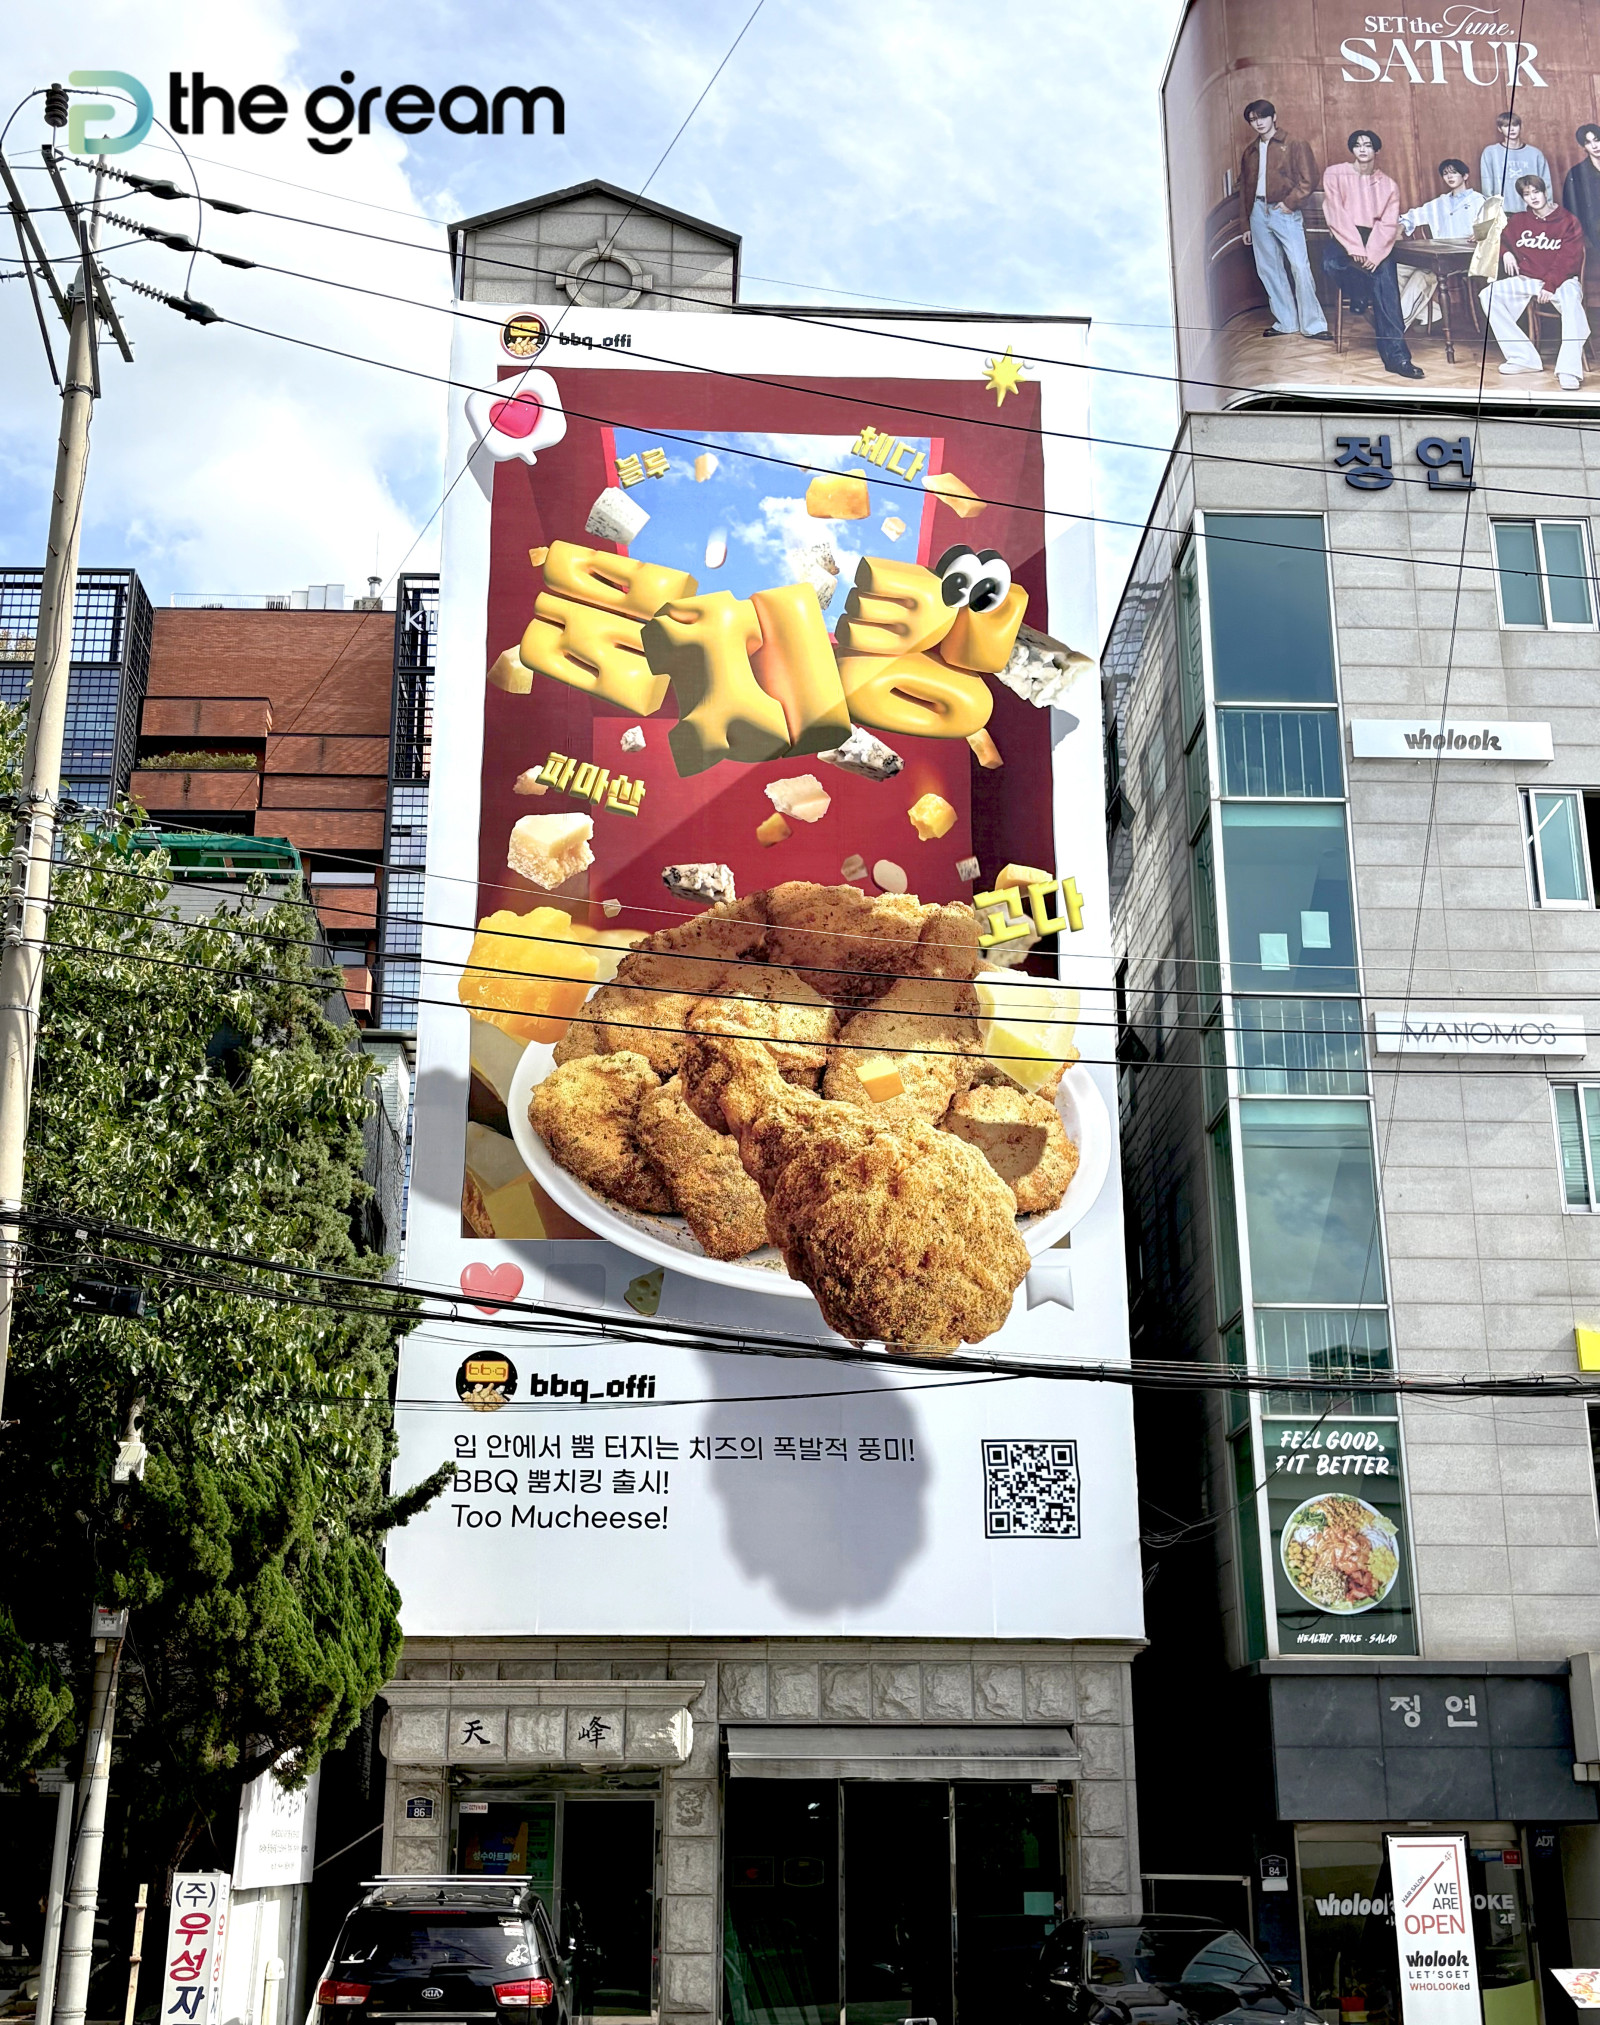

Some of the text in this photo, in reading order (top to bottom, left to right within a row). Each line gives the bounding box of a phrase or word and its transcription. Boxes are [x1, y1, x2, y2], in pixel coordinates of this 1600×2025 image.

[1364, 15, 1408, 33] SET
[1410, 17, 1444, 34] the
[1340, 37, 1549, 87] SATUR
[851, 425, 926, 482] 체다
[1403, 728, 1502, 750] wholook
[535, 751, 646, 817] 파마산
[973, 876, 1084, 948] 고다
[1404, 1022, 1557, 1045] MANOMOS
[530, 1373, 656, 1404] bbq_offi
[454, 1434, 915, 1462] 입 안에서 뿜 터지는 치즈의 폭발적 풍미!
[1281, 1430, 1385, 1452] FEEL GOOD,
[1275, 1454, 1390, 1476] FIT BETTER
[453, 1469, 669, 1496] BBQ 뿜치킹 출시!
[451, 1504, 668, 1530] Too Mucheese!
[1296, 1633, 1398, 1644] HEALTHY POKE SALAD
[413, 1807, 426, 1817] 86
[1535, 1835, 1555, 1847] ADT
[1268, 1866, 1280, 1876] 84
[1410, 1875, 1426, 1893] SALON
[1433, 1882, 1458, 1895] WE
[1432, 1897, 1459, 1910] ARE
[1404, 1914, 1466, 1935] OPEN
[1499, 1913, 1516, 1924] 2F
[1405, 1950, 1469, 1967] wholook
[423, 1988, 441, 1998] KIA
[1409, 1982, 1470, 1991] WHOLOOKed
